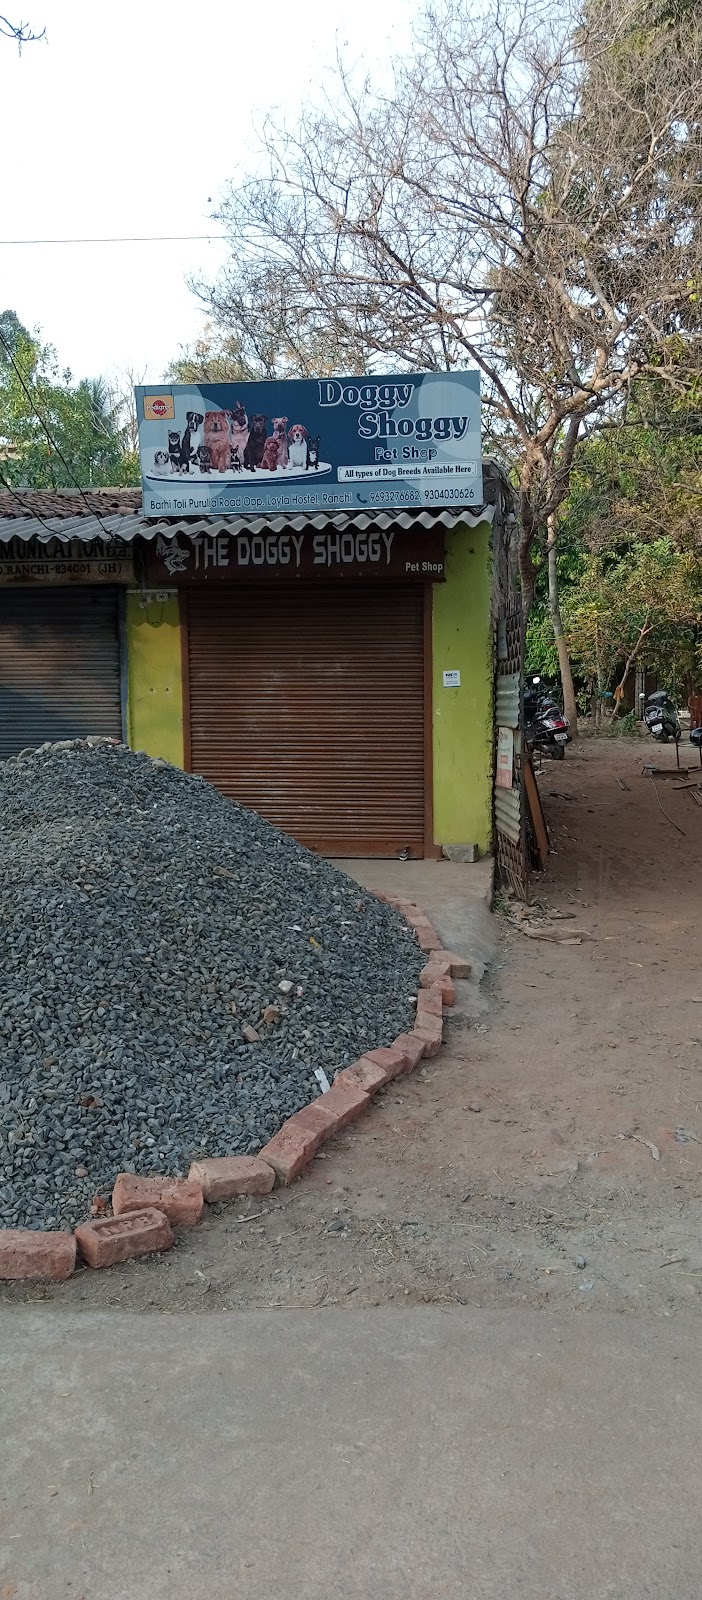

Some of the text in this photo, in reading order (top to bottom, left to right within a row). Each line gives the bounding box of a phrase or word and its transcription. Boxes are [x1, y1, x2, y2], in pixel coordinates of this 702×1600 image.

[318, 379, 415, 410] Doggy
[357, 412, 471, 441] Shoggy
[375, 445, 438, 461] Pet Shop
[344, 465, 471, 479] All types of Dog Breeds Available Here
[150, 489, 475, 510] Barhi Toli Purulia Road Opp. Loyla Hostel, Ranchi 9693276682, 9304030626
[191, 532, 395, 570] THE DOGGY SHOGGY
[98, 562, 122, 575] (JH)
[405, 561, 443, 573] Pet Shop
